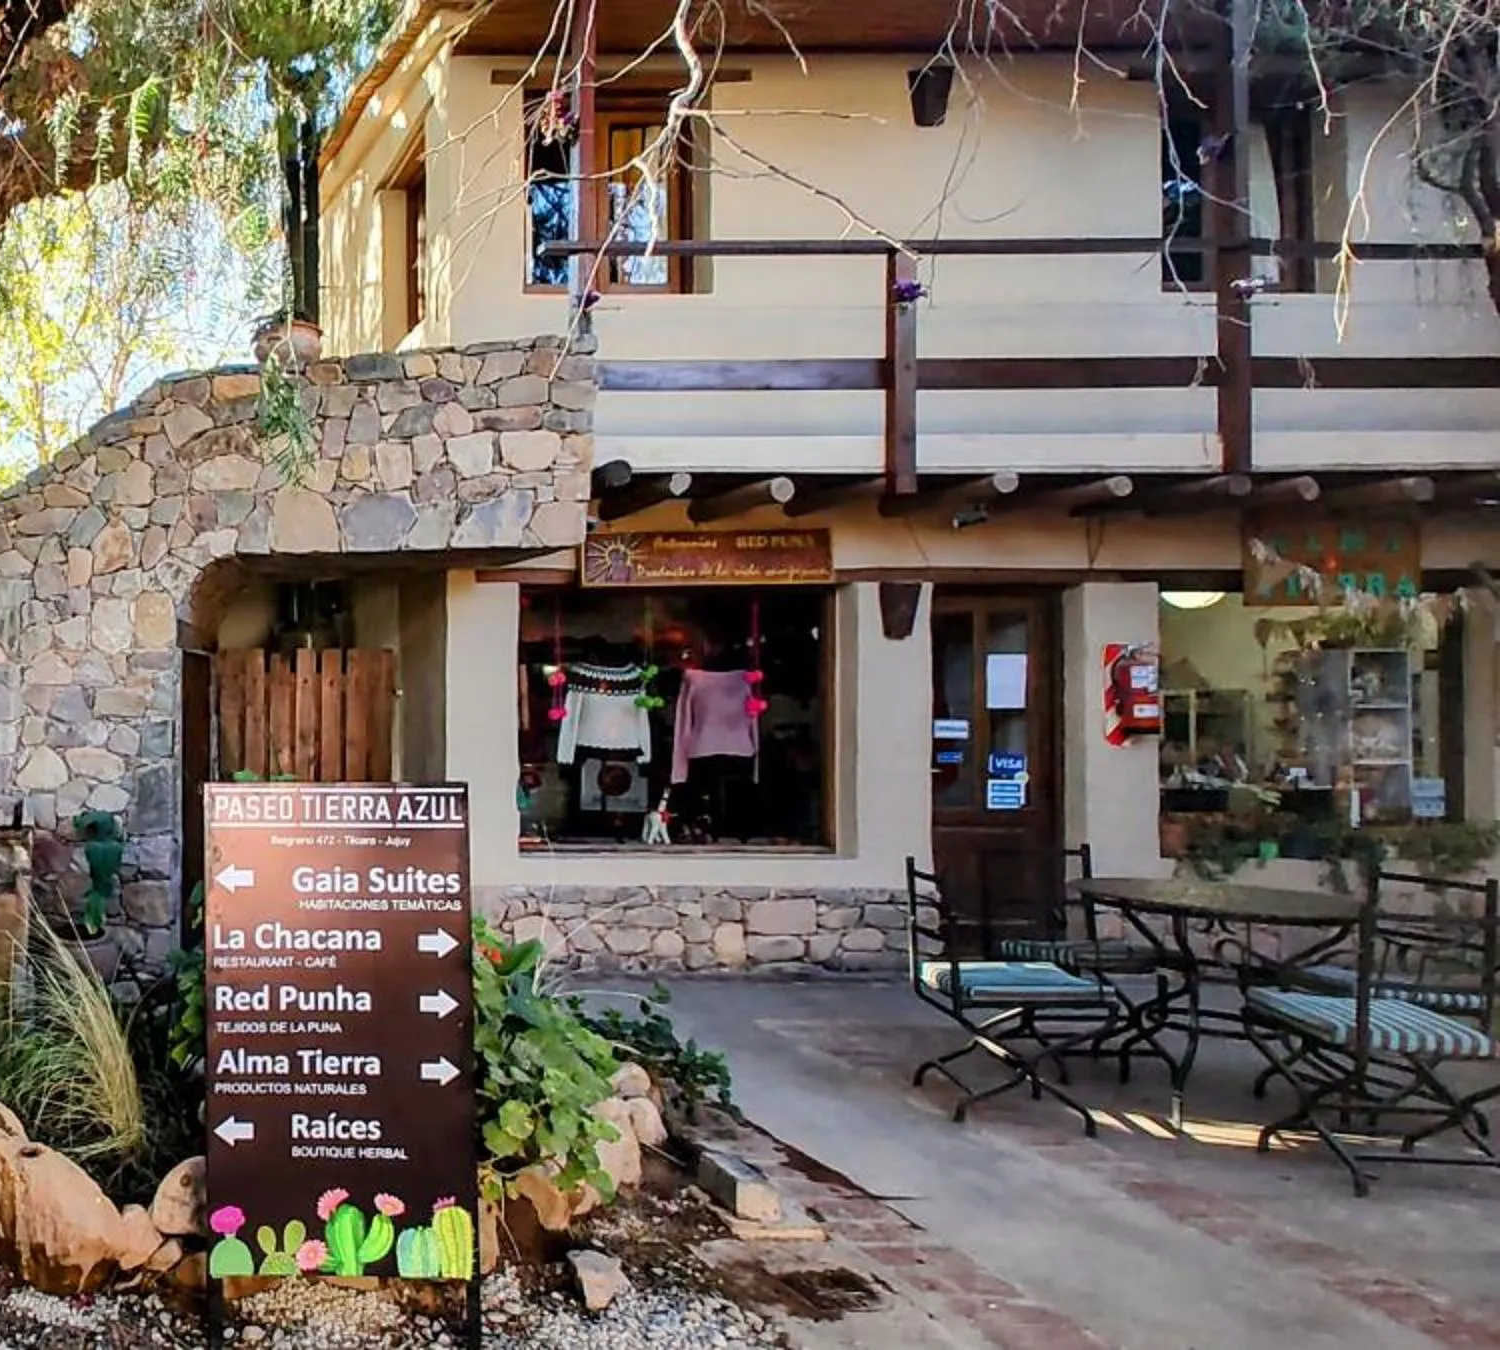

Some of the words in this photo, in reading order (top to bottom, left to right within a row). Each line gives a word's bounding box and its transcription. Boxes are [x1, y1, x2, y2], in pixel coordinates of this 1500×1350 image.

[994, 757, 1023, 769] VISA
[214, 795, 294, 821] PASEO
[301, 795, 392, 821] TIERRA
[396, 796, 464, 821] AZUL
[292, 866, 360, 894] Gaia
[368, 866, 461, 894] Suites
[299, 899, 389, 911] HABITACIONES
[392, 898, 462, 911] TEMÁTICAS
[214, 924, 245, 950] La
[255, 923, 382, 950] Chacana
[214, 956, 294, 967] RESTAURANT
[304, 955, 337, 968] CAFÉ
[215, 985, 269, 1011] Red
[280, 985, 372, 1012] Punha
[217, 1022, 267, 1033] TEJIDOS
[270, 1022, 286, 1033] DE
[290, 1022, 306, 1033] LA
[307, 1022, 342, 1033] PUNA
[216, 1048, 289, 1075] Alma
[297, 1049, 381, 1075] Tierra
[214, 1083, 292, 1094] PRODUCTOS
[294, 1083, 367, 1095] NATURALES
[291, 1112, 382, 1140] Raíces
[291, 1146, 356, 1158] BOUTIQUE
[359, 1147, 409, 1159] HERBAL
